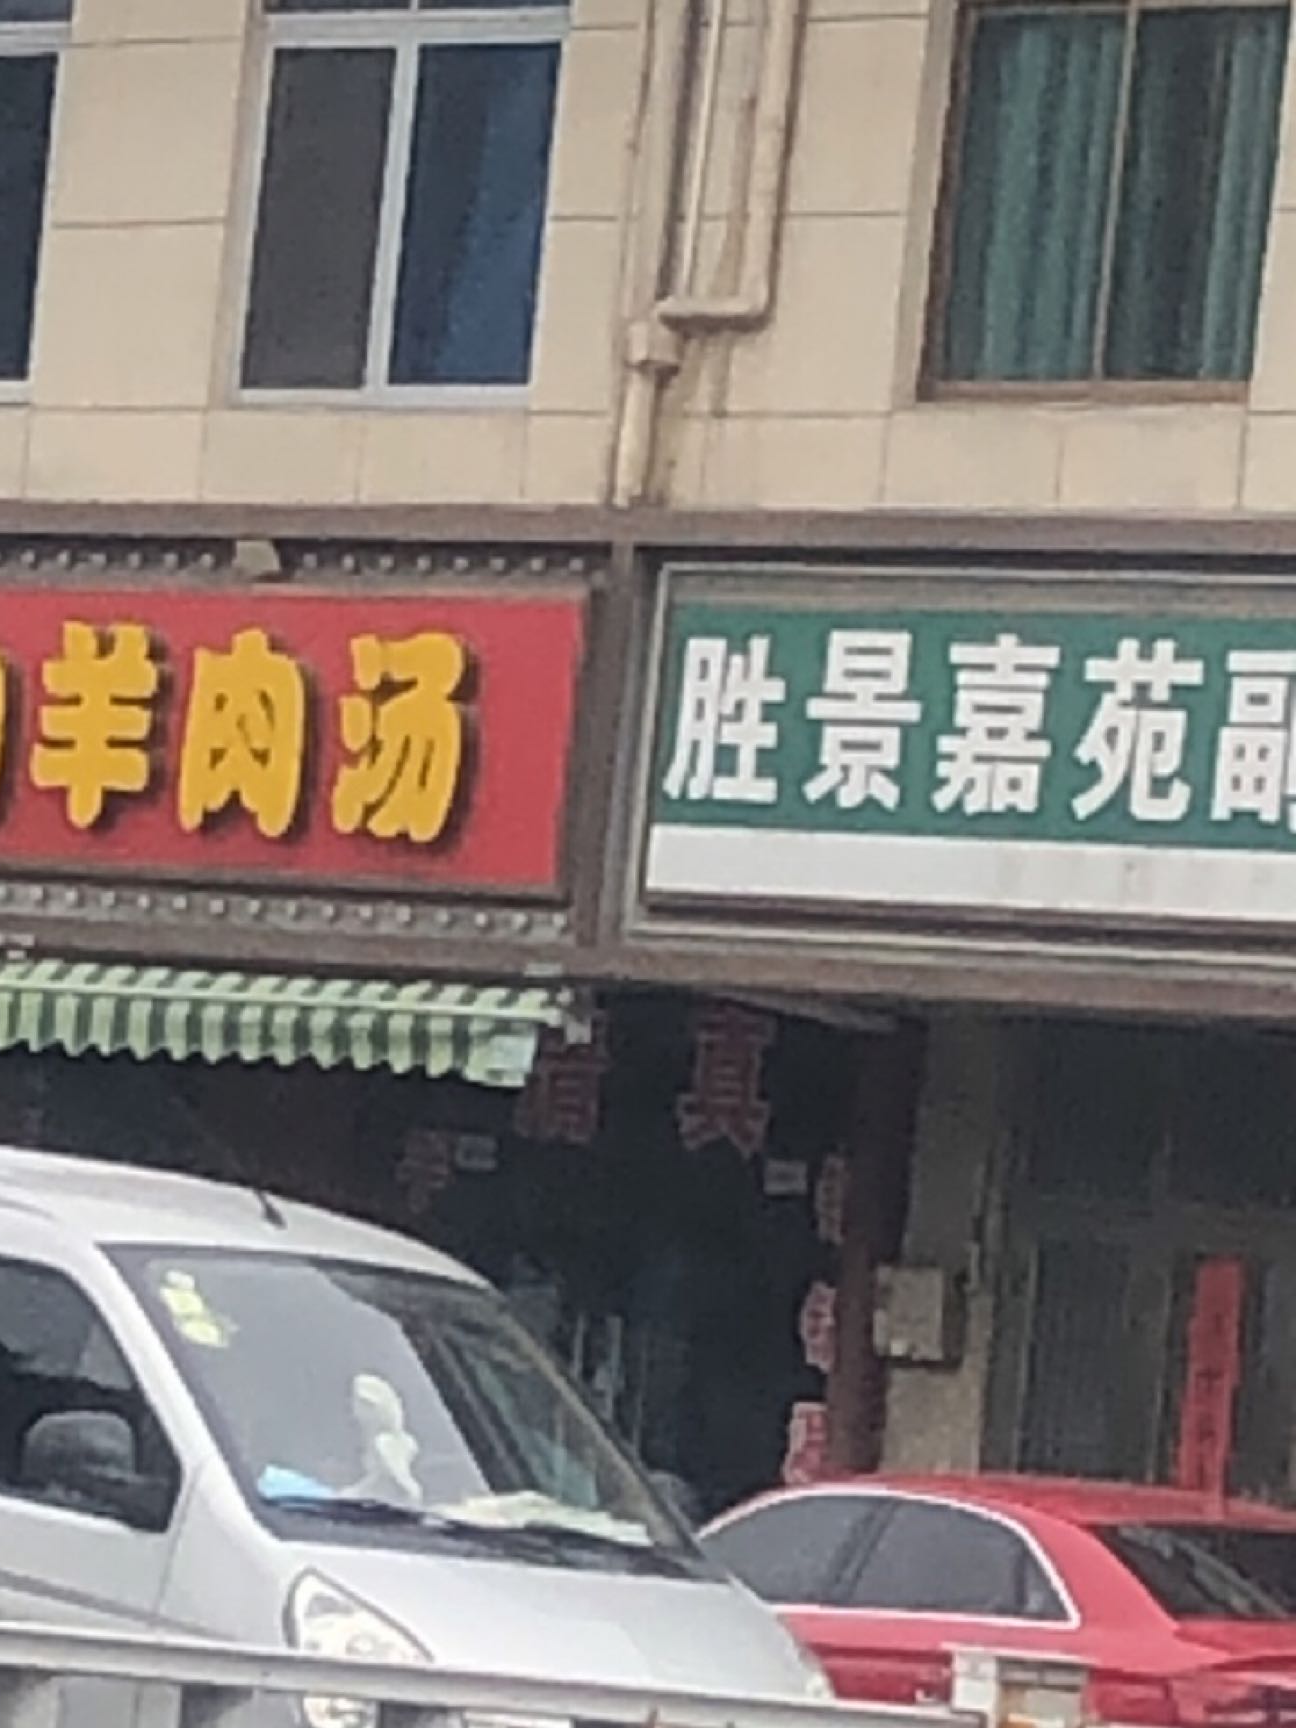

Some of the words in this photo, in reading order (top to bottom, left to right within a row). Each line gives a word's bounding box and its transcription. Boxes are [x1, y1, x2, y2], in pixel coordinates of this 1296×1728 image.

[664, 630, 1296, 832] 胜景嘉苑副
